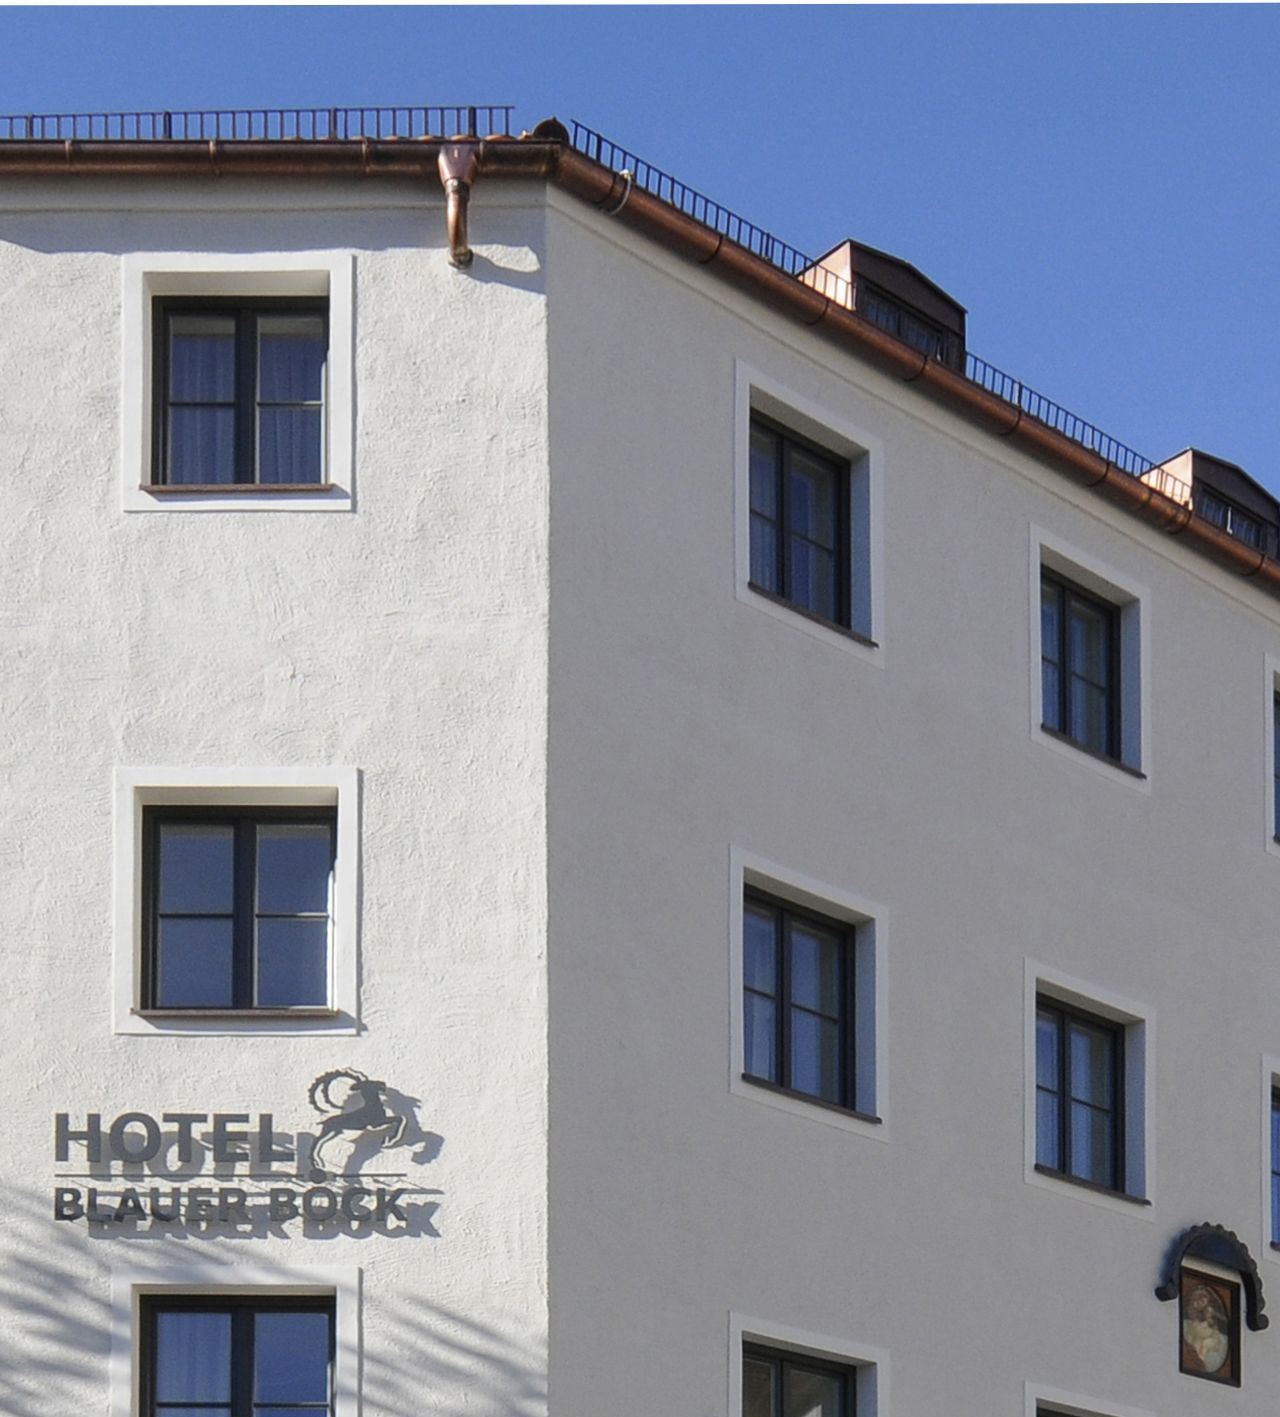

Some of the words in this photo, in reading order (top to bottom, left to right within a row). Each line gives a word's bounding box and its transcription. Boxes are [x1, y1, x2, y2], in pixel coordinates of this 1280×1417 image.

[55, 1112, 295, 1163] HOTEL
[55, 1187, 248, 1221] BLAUER
[270, 1187, 408, 1221] BOCK
